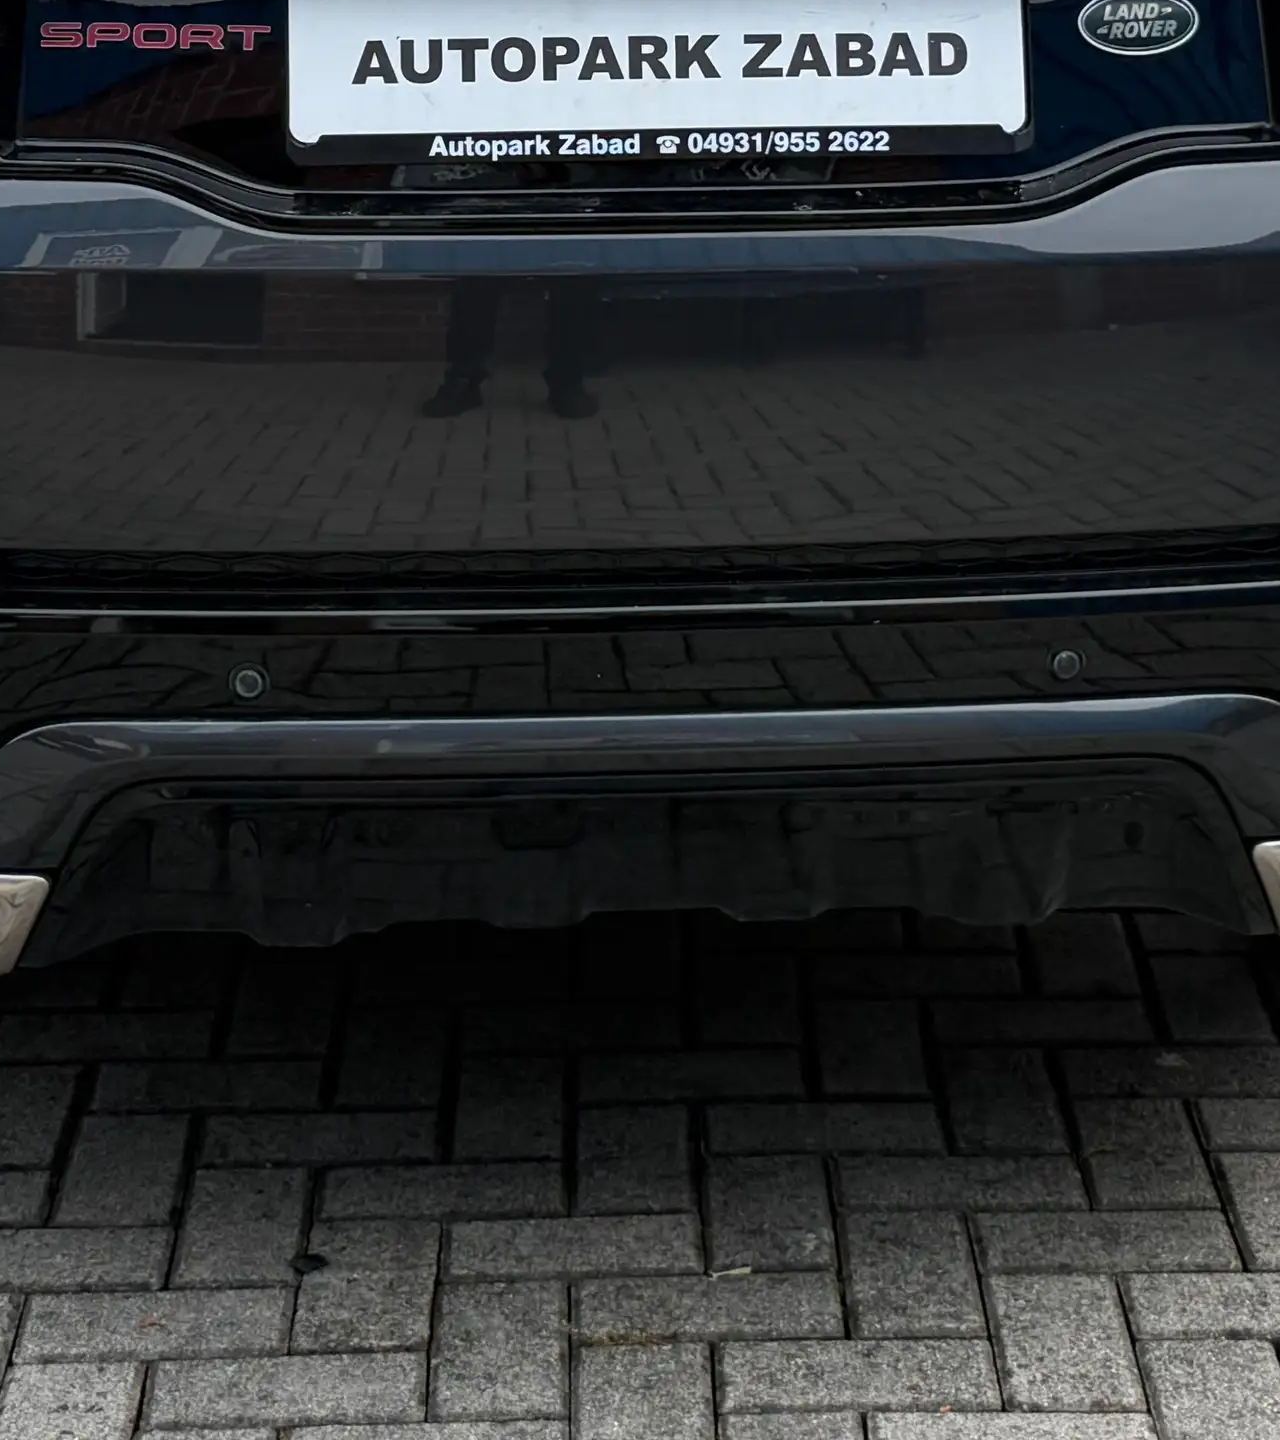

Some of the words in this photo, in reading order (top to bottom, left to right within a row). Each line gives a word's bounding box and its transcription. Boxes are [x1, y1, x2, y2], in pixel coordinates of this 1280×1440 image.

[1103, 2, 1161, 21] LAND
[40, 21, 272, 51] SPORT
[1108, 19, 1178, 39] ROVER
[352, 34, 721, 85] AUTOPARK
[742, 32, 968, 78] ZABAD
[428, 133, 550, 161] Autopark
[558, 133, 641, 156] Zabad
[687, 131, 820, 155] 04931/955
[828, 131, 890, 152] 2622
